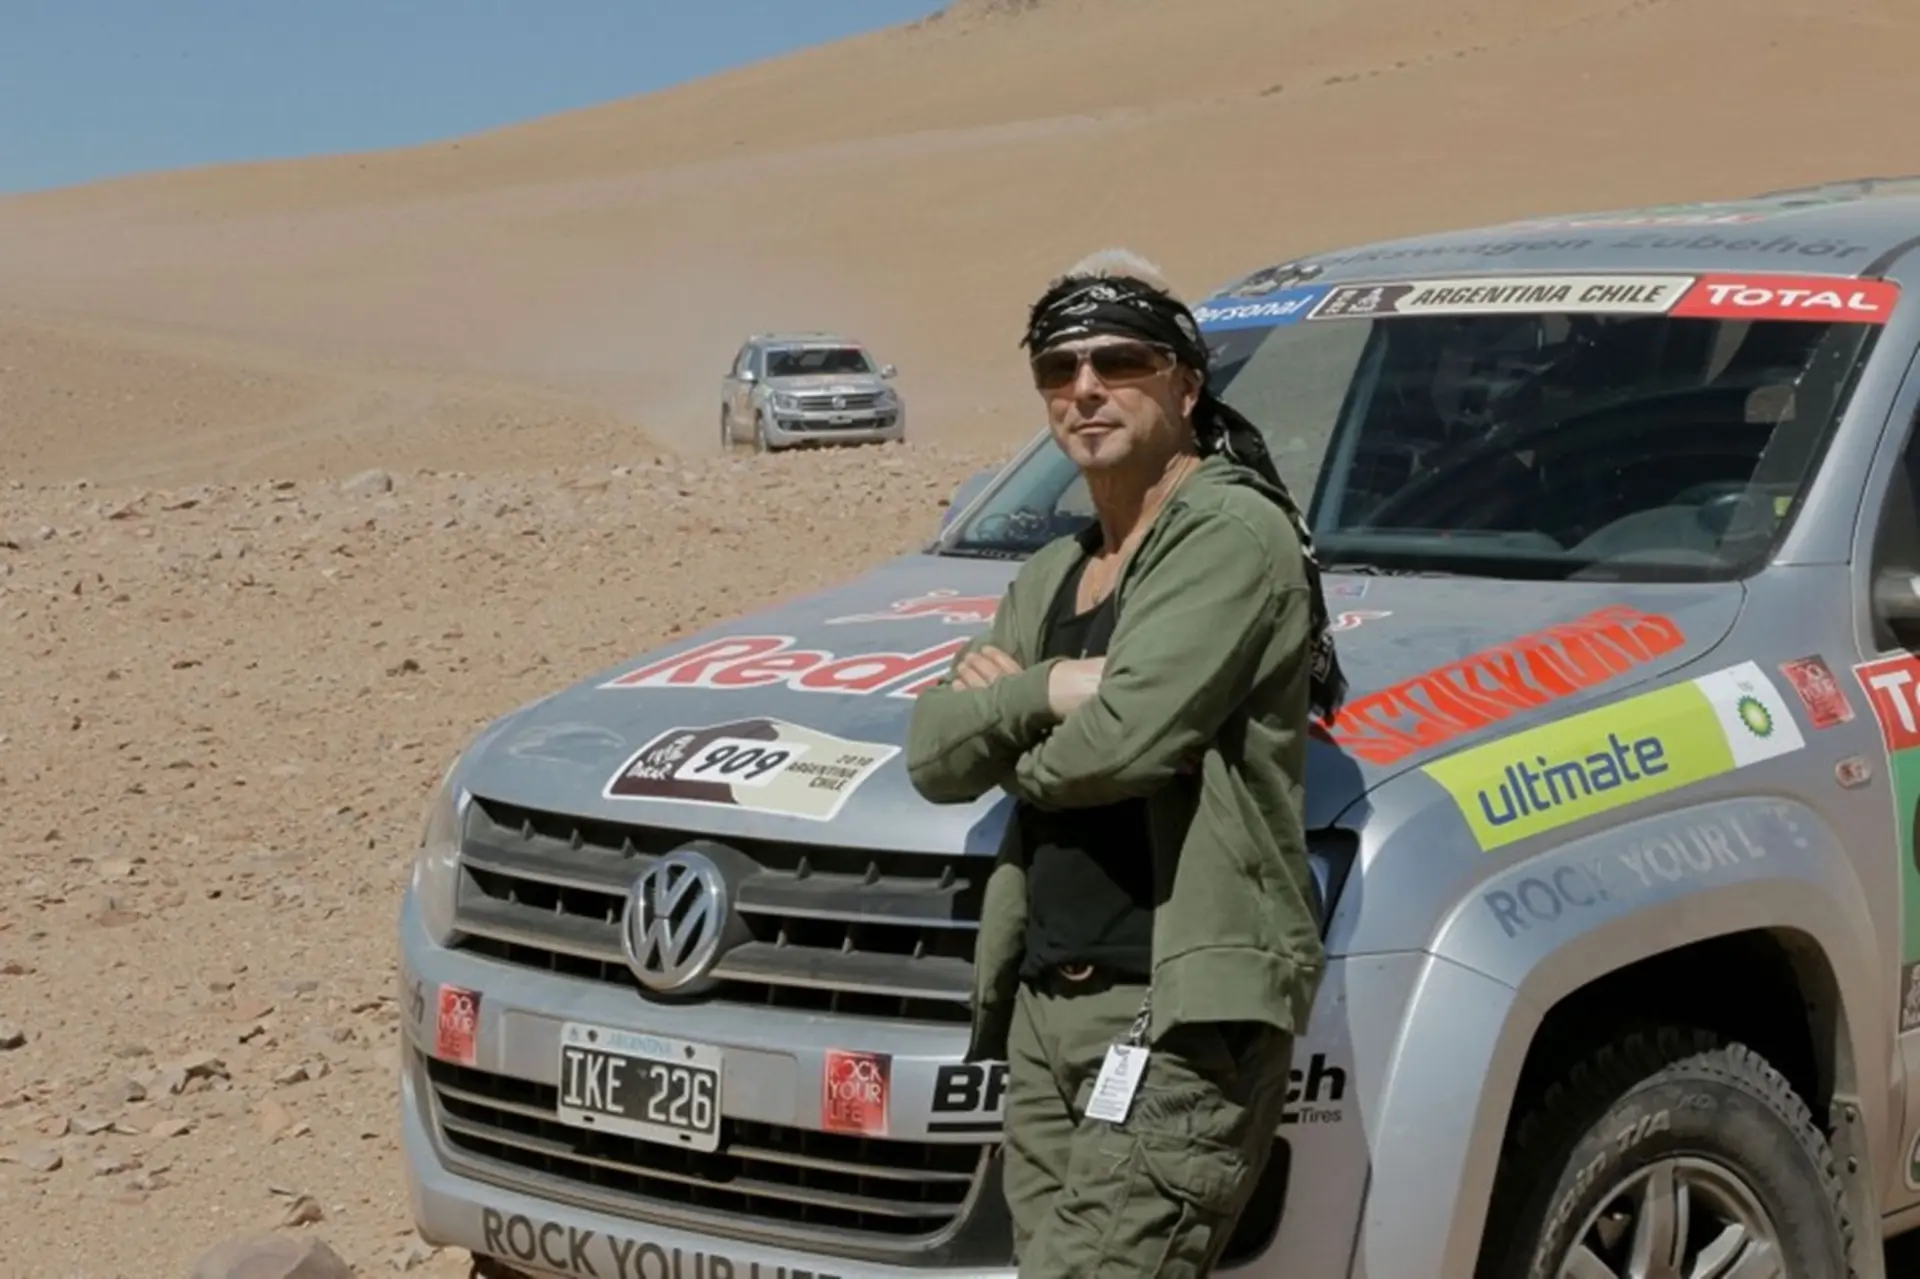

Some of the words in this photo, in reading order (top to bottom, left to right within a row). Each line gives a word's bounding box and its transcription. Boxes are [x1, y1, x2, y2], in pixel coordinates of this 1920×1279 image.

[1410, 284, 1573, 306] ARGENTINA
[1578, 283, 1668, 304] CHILE
[1706, 283, 1879, 312] TOTAL
[595, 634, 970, 695] Red
[693, 744, 790, 781] 909
[1477, 732, 1670, 827] ultimate
[1617, 822, 1742, 892] YOUR
[563, 1051, 627, 1114] IKE
[647, 1064, 714, 1130] 226
[828, 1079, 881, 1104] YOUR
[1300, 1107, 1343, 1125] Tires
[481, 1206, 600, 1277] ROCK
